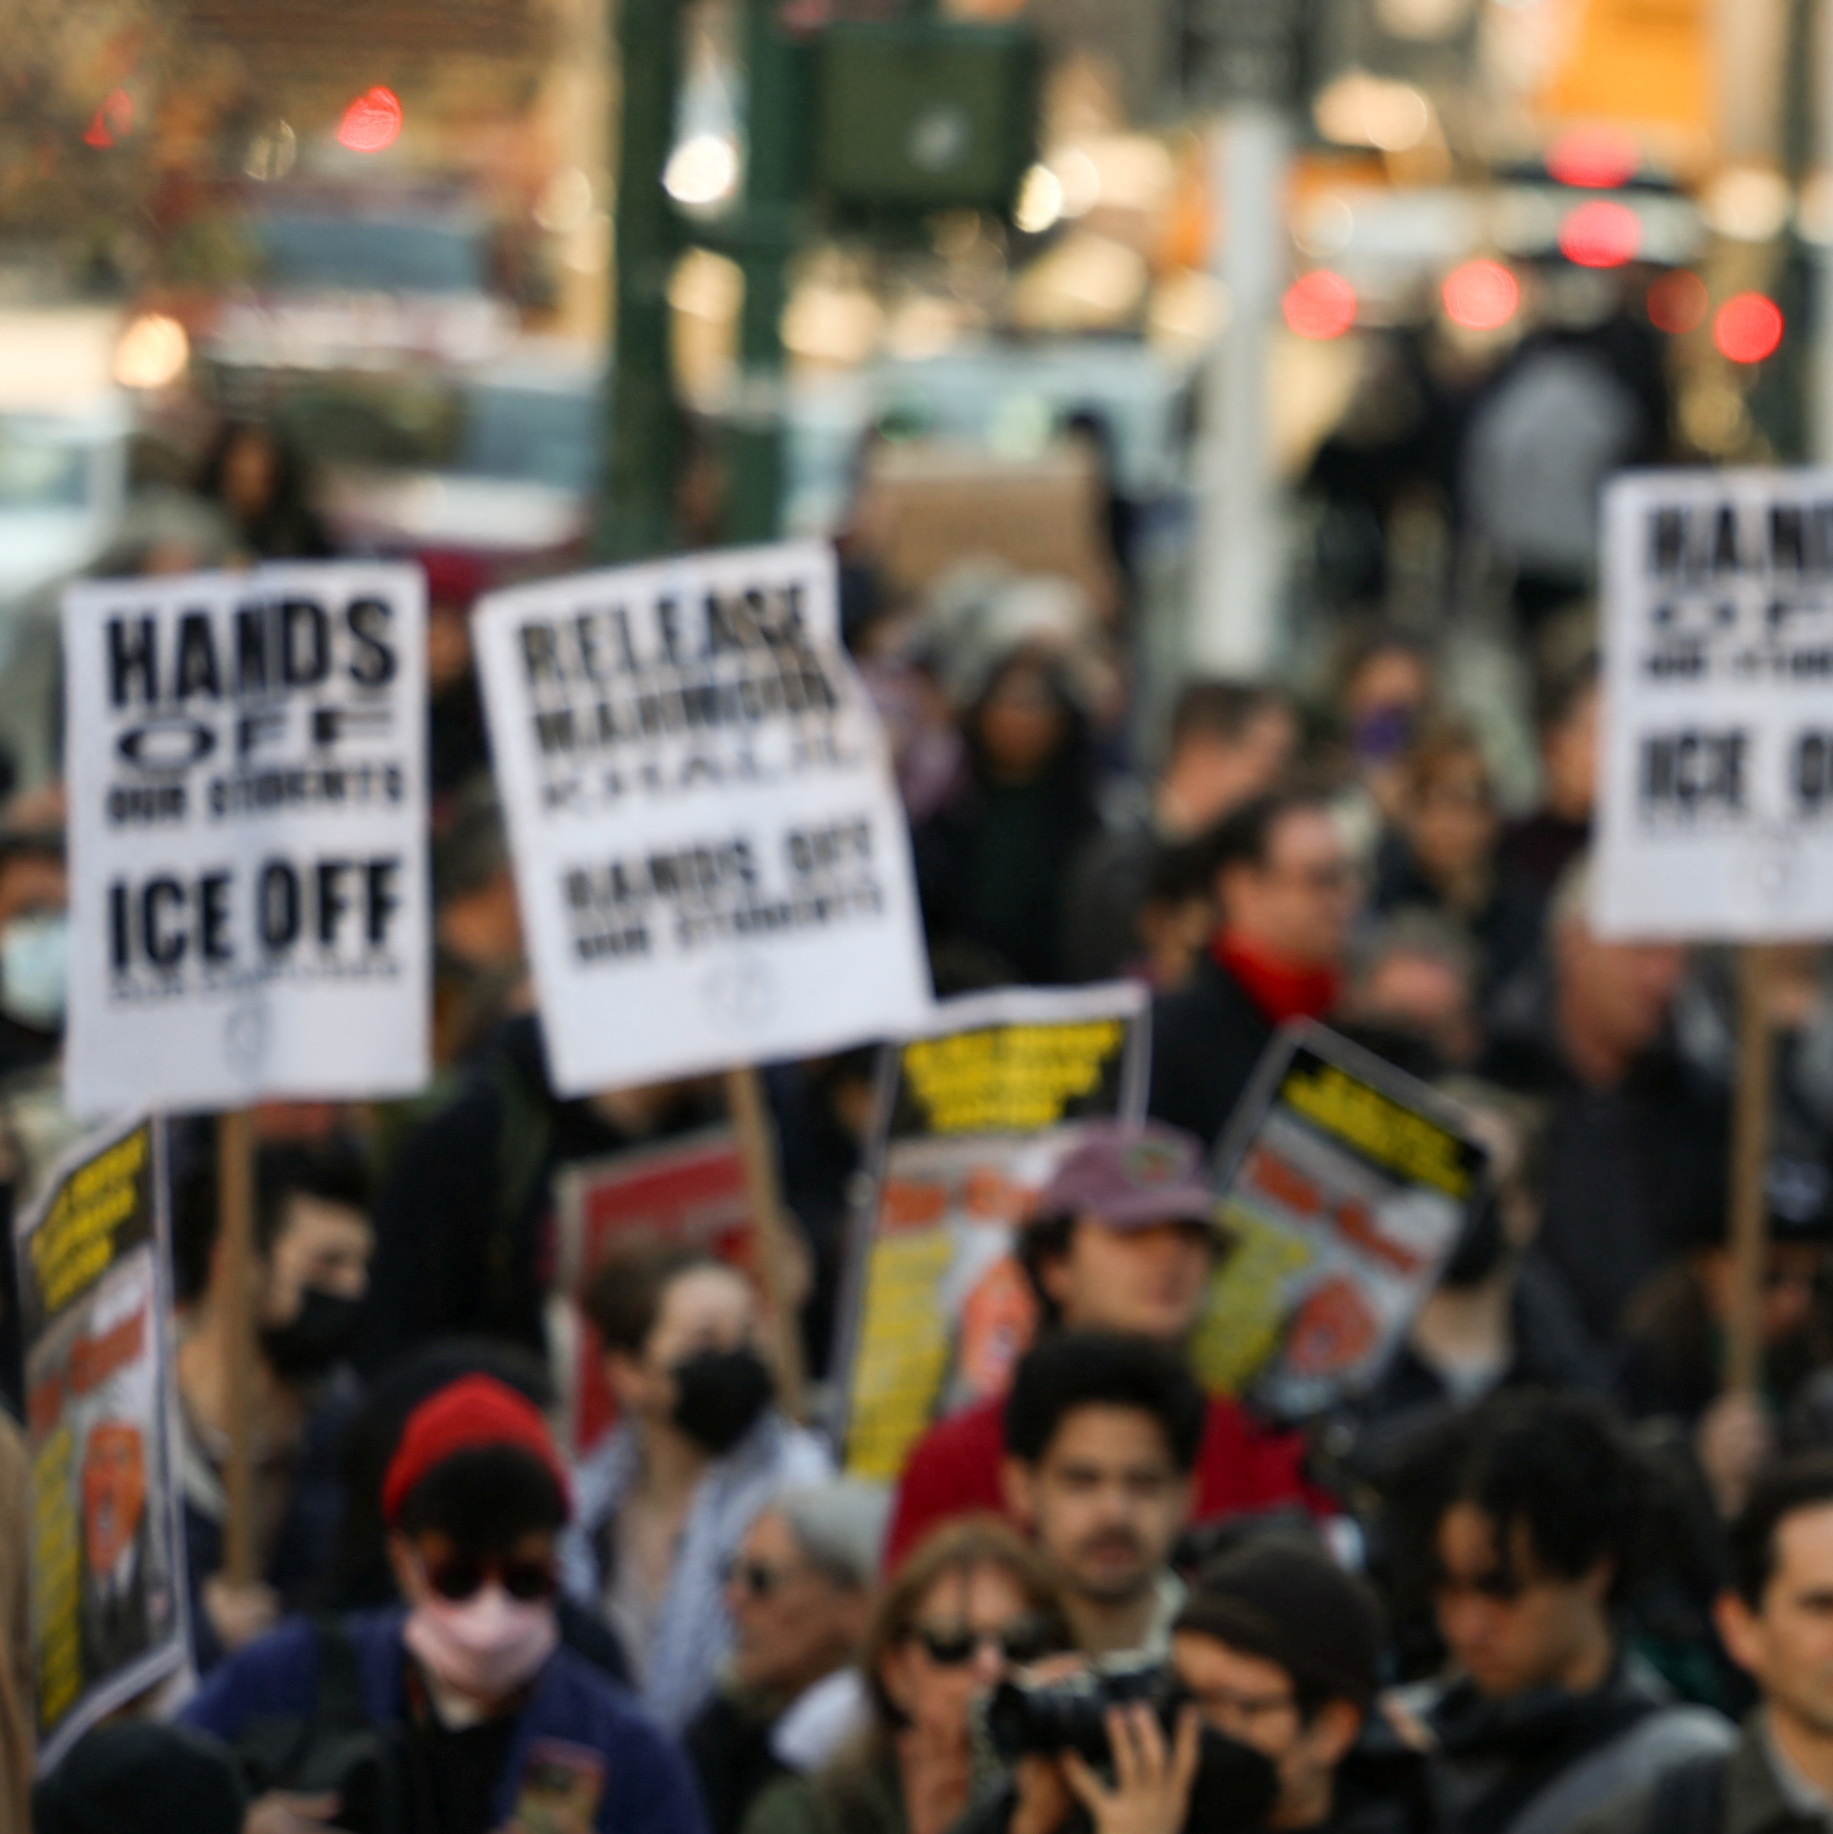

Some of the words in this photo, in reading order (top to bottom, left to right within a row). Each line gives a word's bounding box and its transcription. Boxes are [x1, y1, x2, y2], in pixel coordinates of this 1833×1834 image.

[107, 597, 398, 706] HANDS
[107, 870, 234, 972] ICE
[257, 858, 403, 950] OFF
